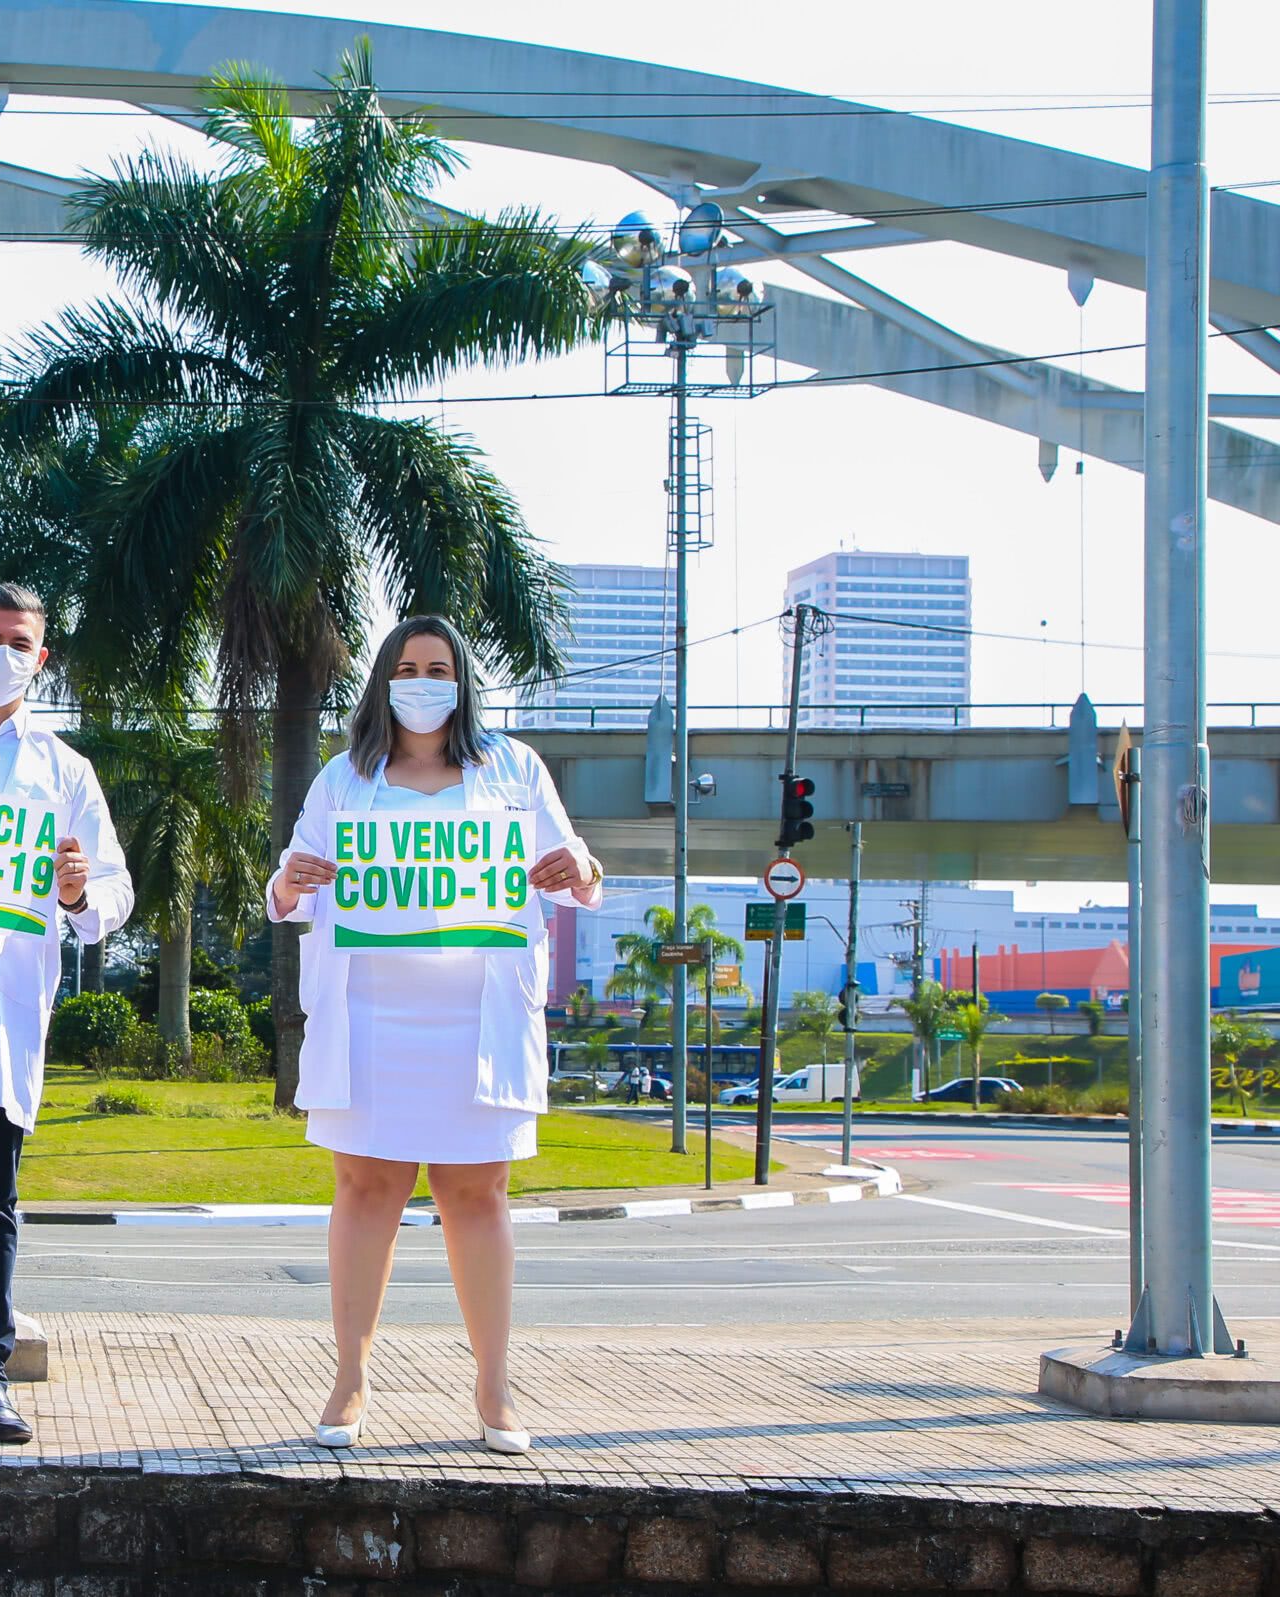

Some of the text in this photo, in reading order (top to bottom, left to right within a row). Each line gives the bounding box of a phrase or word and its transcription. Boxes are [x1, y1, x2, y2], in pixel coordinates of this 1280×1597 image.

[34, 812, 56, 853] A
[336, 821, 526, 863] EU VENCI A
[335, 865, 528, 911] COVID-19
